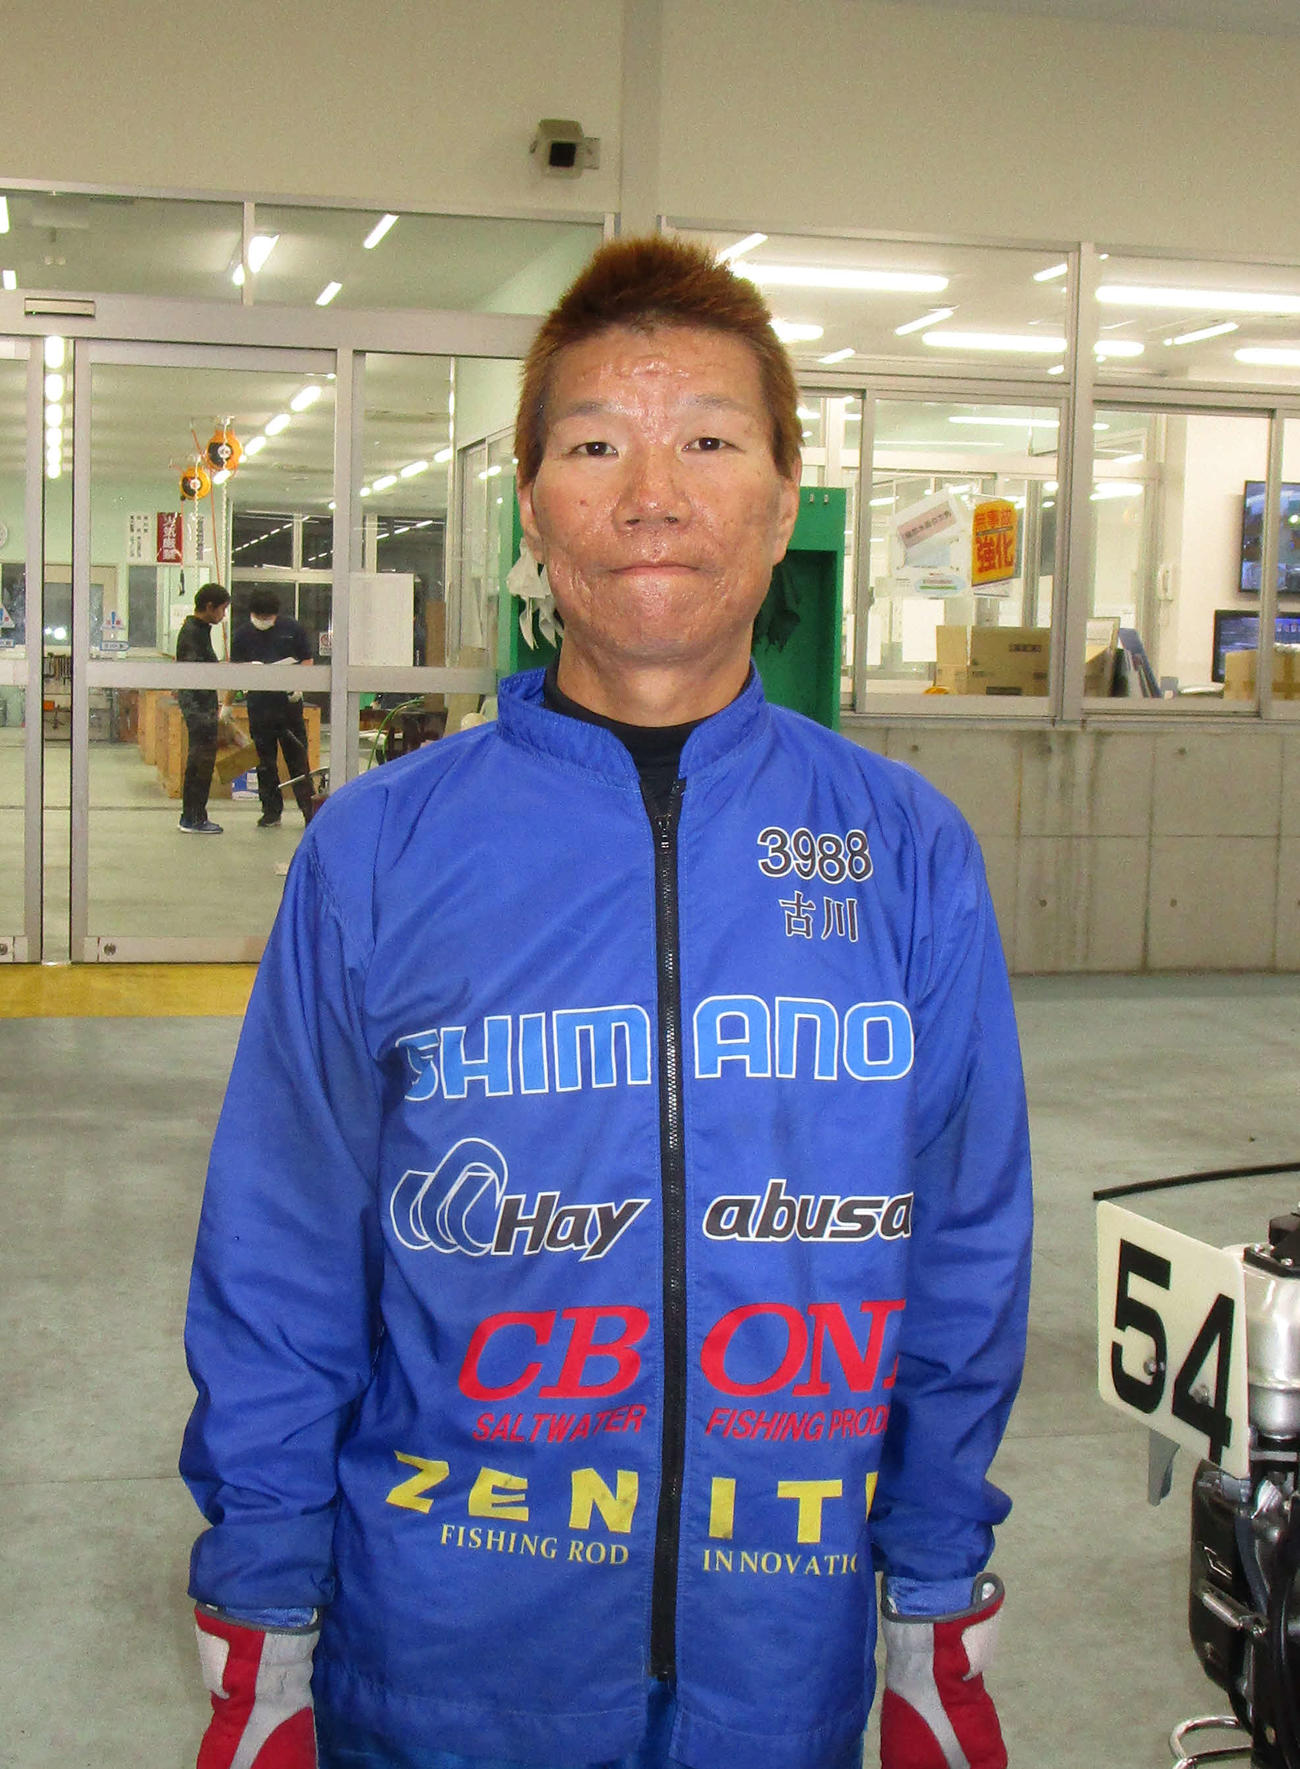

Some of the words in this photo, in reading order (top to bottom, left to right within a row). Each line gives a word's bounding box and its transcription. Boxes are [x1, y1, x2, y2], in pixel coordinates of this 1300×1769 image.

[976, 533, 1014, 574] 強化
[757, 826, 874, 885] 3988
[778, 890, 859, 943] 古川
[692, 994, 915, 1082] ANO
[491, 1191, 652, 1263] Hay
[702, 1178, 915, 1243] abusa
[457, 1305, 651, 1402] CB
[700, 1298, 907, 1398] ON
[1111, 1238, 1236, 1467] 54
[471, 1403, 648, 1444] SALTWATER
[704, 1407, 826, 1442] FISHING
[385, 1449, 639, 1535] ZEN
[708, 1471, 879, 1545] IT
[440, 1523, 558, 1560] FISHING
[567, 1539, 630, 1566] ROD
